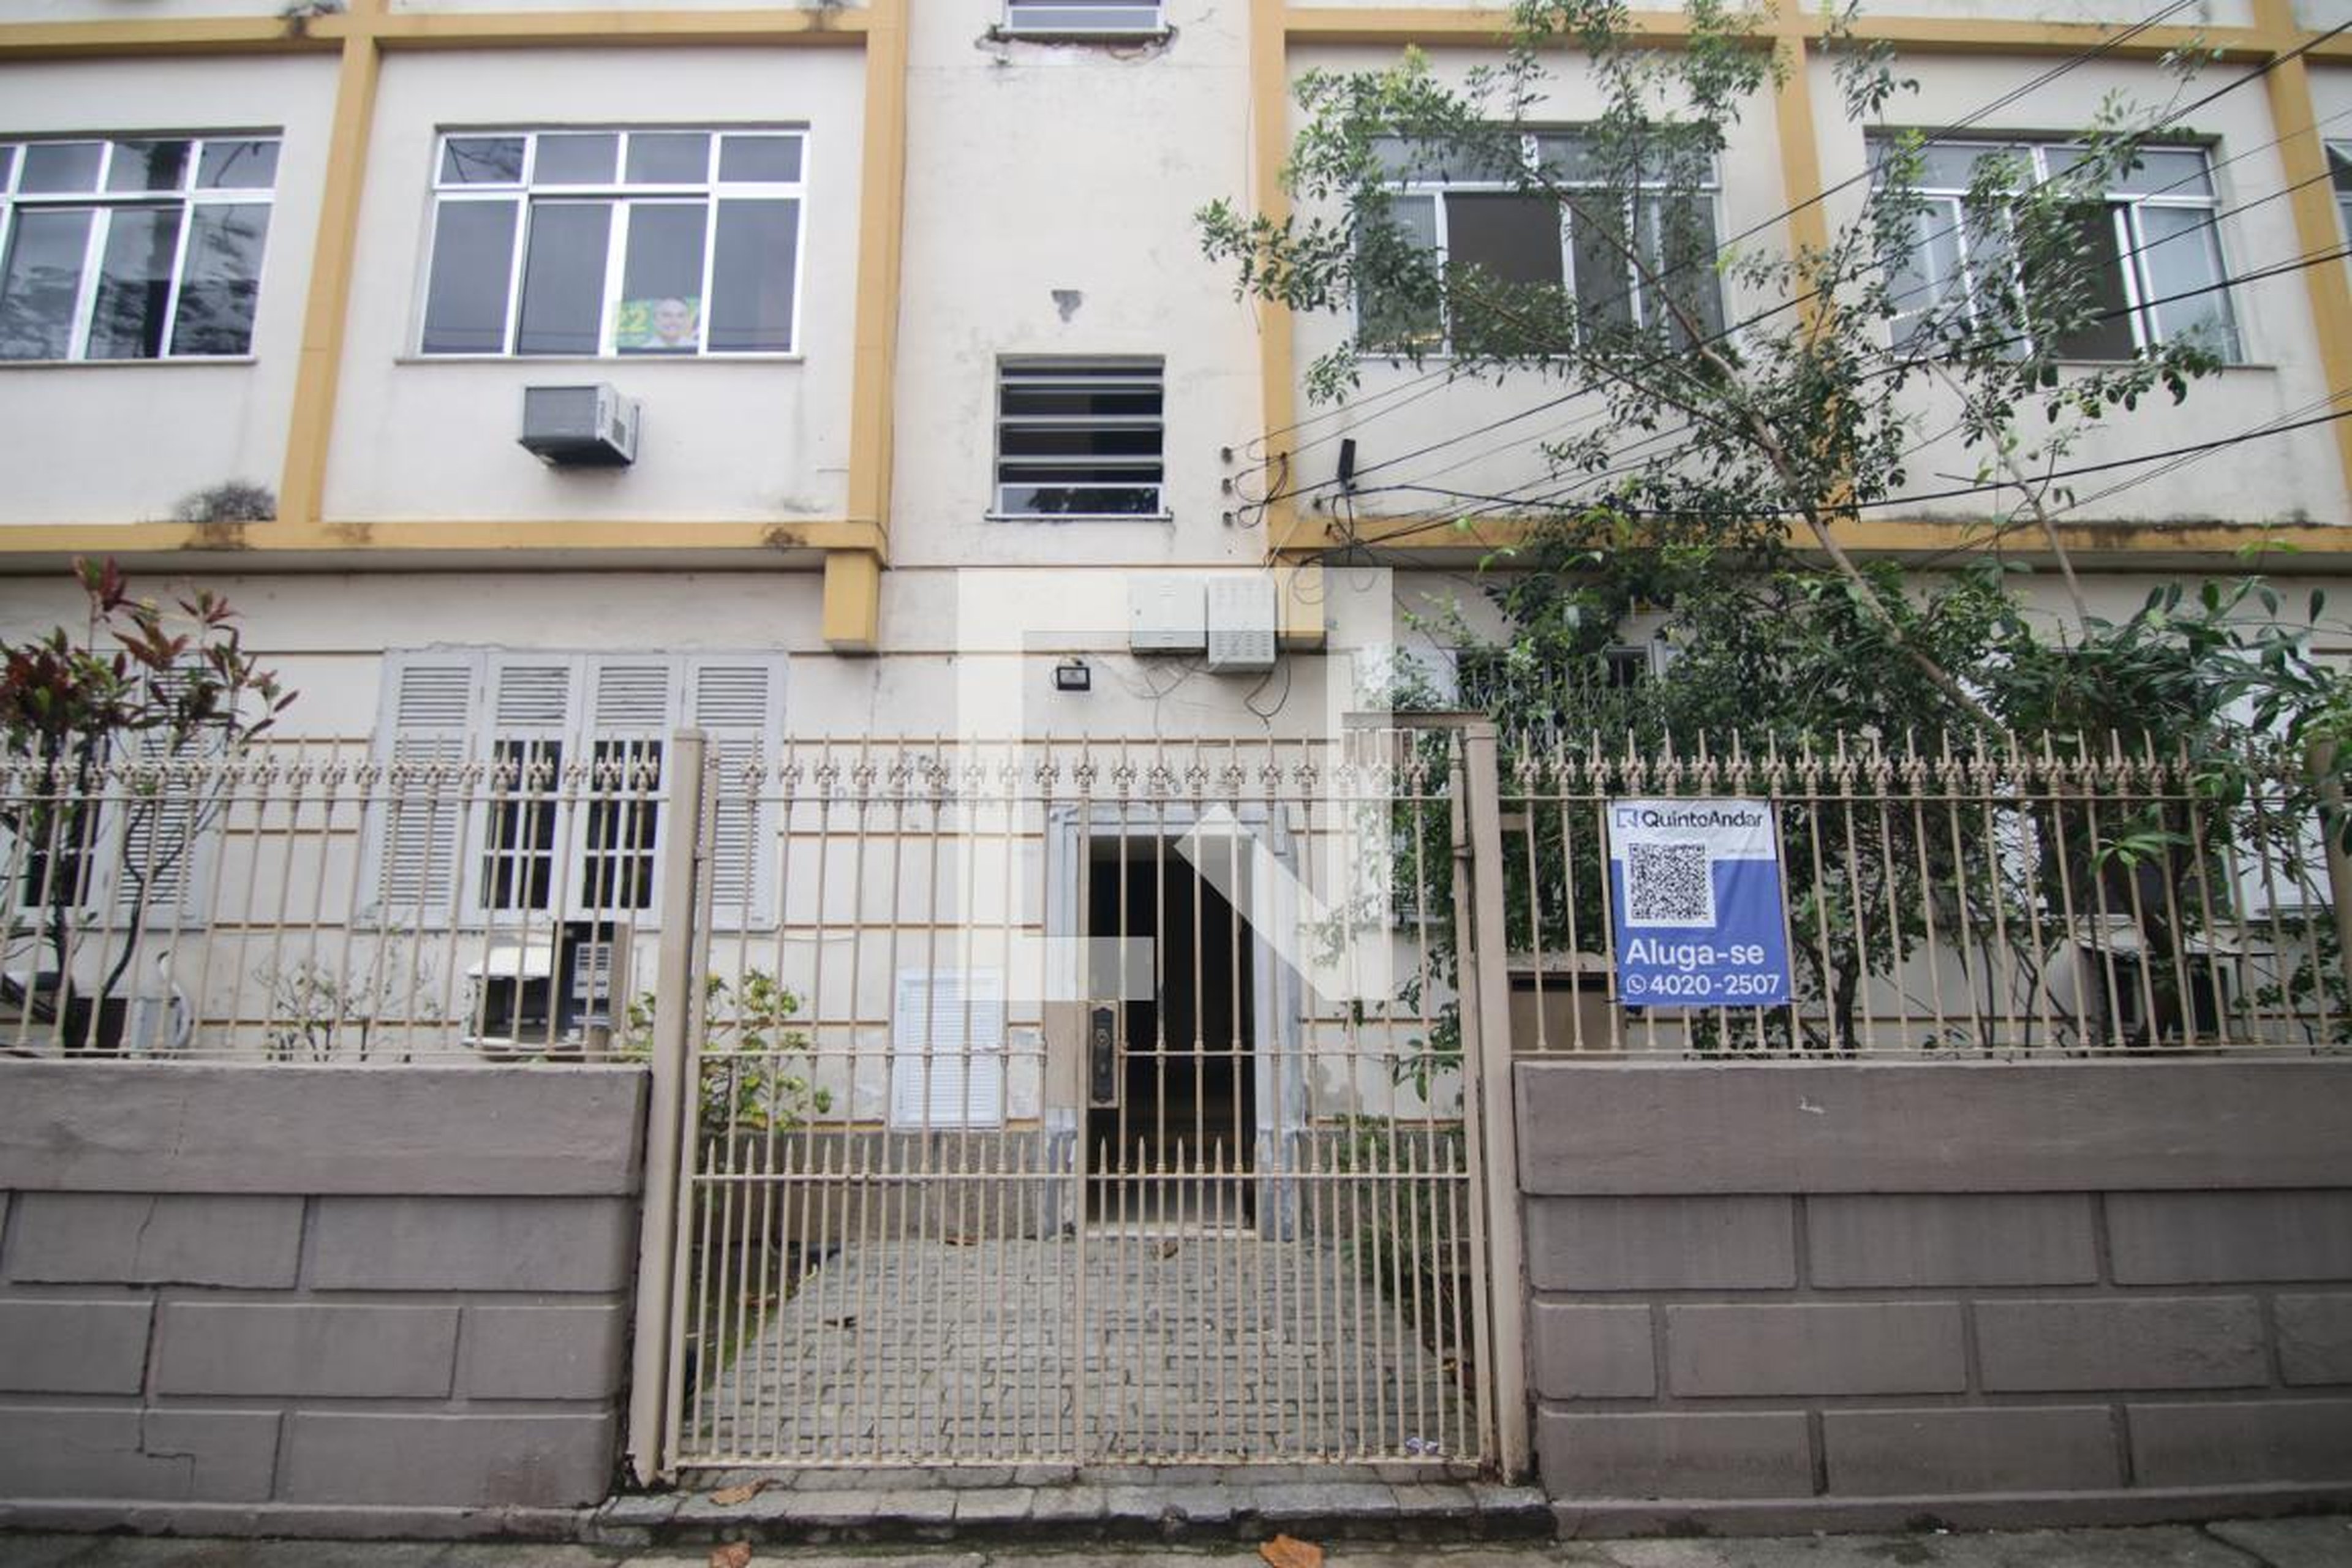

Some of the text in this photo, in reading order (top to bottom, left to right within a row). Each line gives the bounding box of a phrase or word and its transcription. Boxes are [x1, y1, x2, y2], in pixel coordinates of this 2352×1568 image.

[1642, 810, 1763, 827] QuintoAndar
[1624, 938, 1765, 971] Aluga-se
[1649, 974, 1780, 995] 4020-2507
